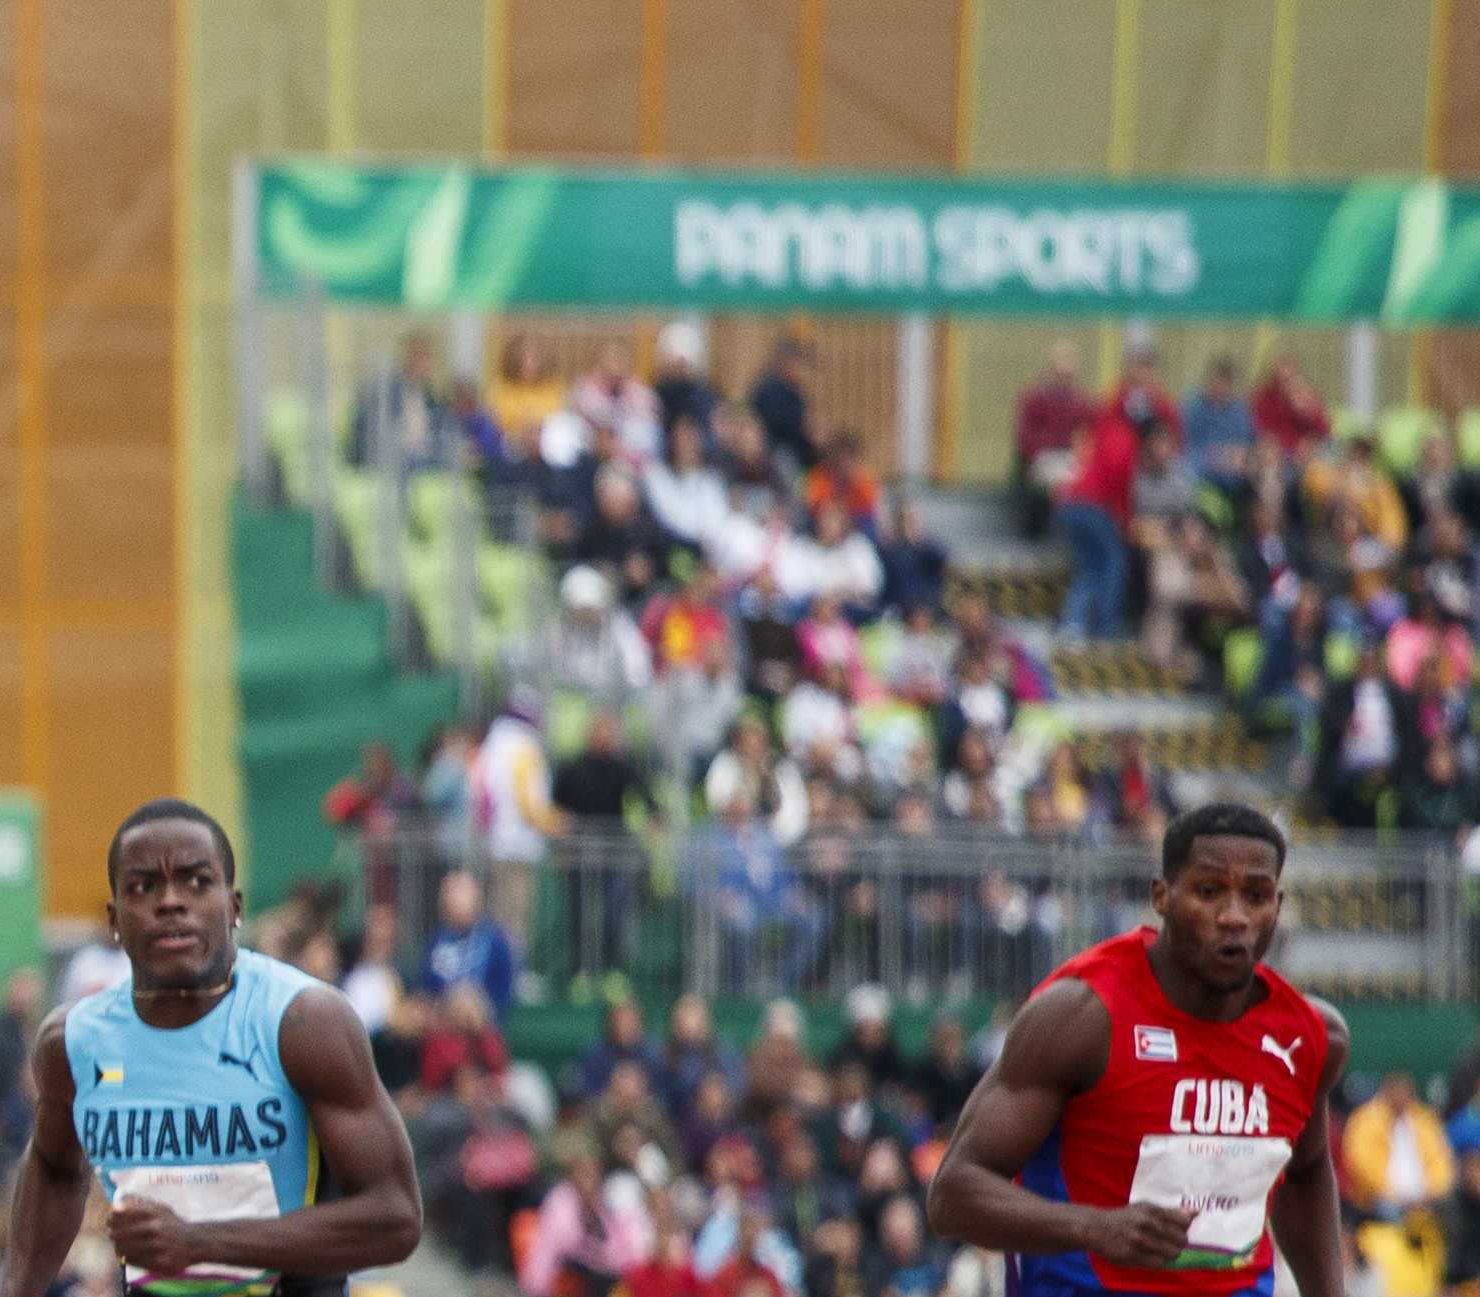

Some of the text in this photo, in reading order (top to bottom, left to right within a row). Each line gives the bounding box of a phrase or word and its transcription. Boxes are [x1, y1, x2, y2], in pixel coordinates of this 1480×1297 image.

[676, 199, 1201, 296] PANAM SPORTS
[83, 1097, 287, 1158] BAHAMAS
[1170, 1078, 1270, 1135] CUBA
